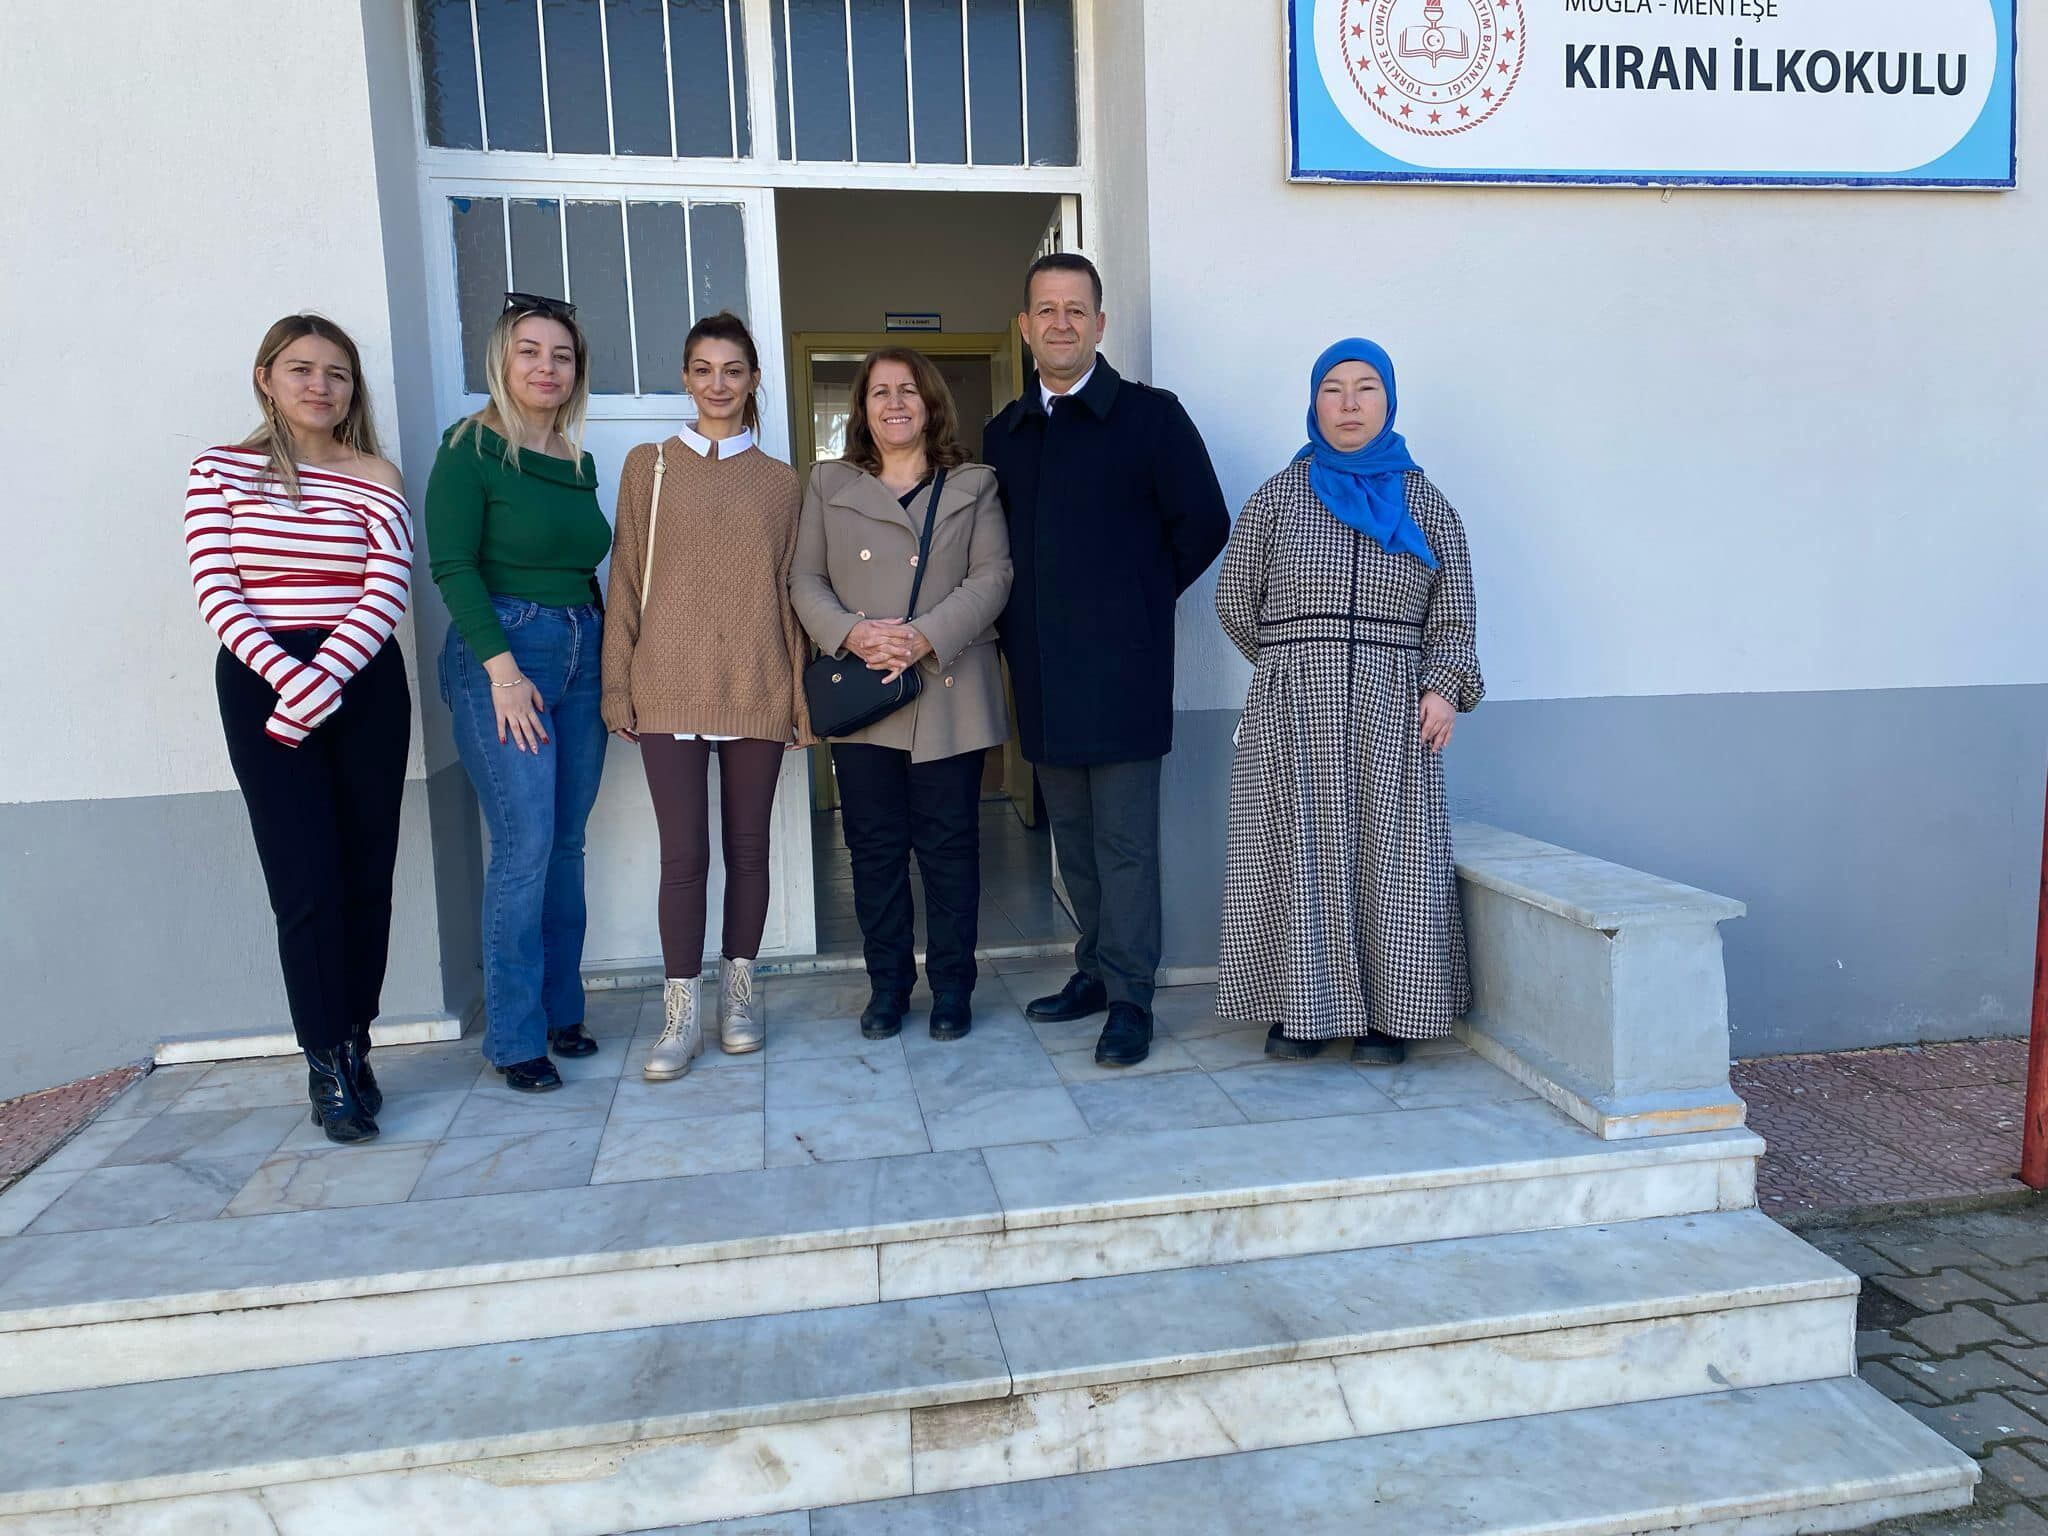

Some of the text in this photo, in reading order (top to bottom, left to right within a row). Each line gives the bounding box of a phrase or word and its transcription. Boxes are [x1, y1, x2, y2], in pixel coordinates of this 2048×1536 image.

[1673, 0, 1778, 23] MENTEŞE
[1379, 50, 1422, 96] TÜRKİYE
[1448, 35, 1492, 96] BAKANLIĞI
[1565, 37, 1967, 96] KIRAN İLKOKULU
